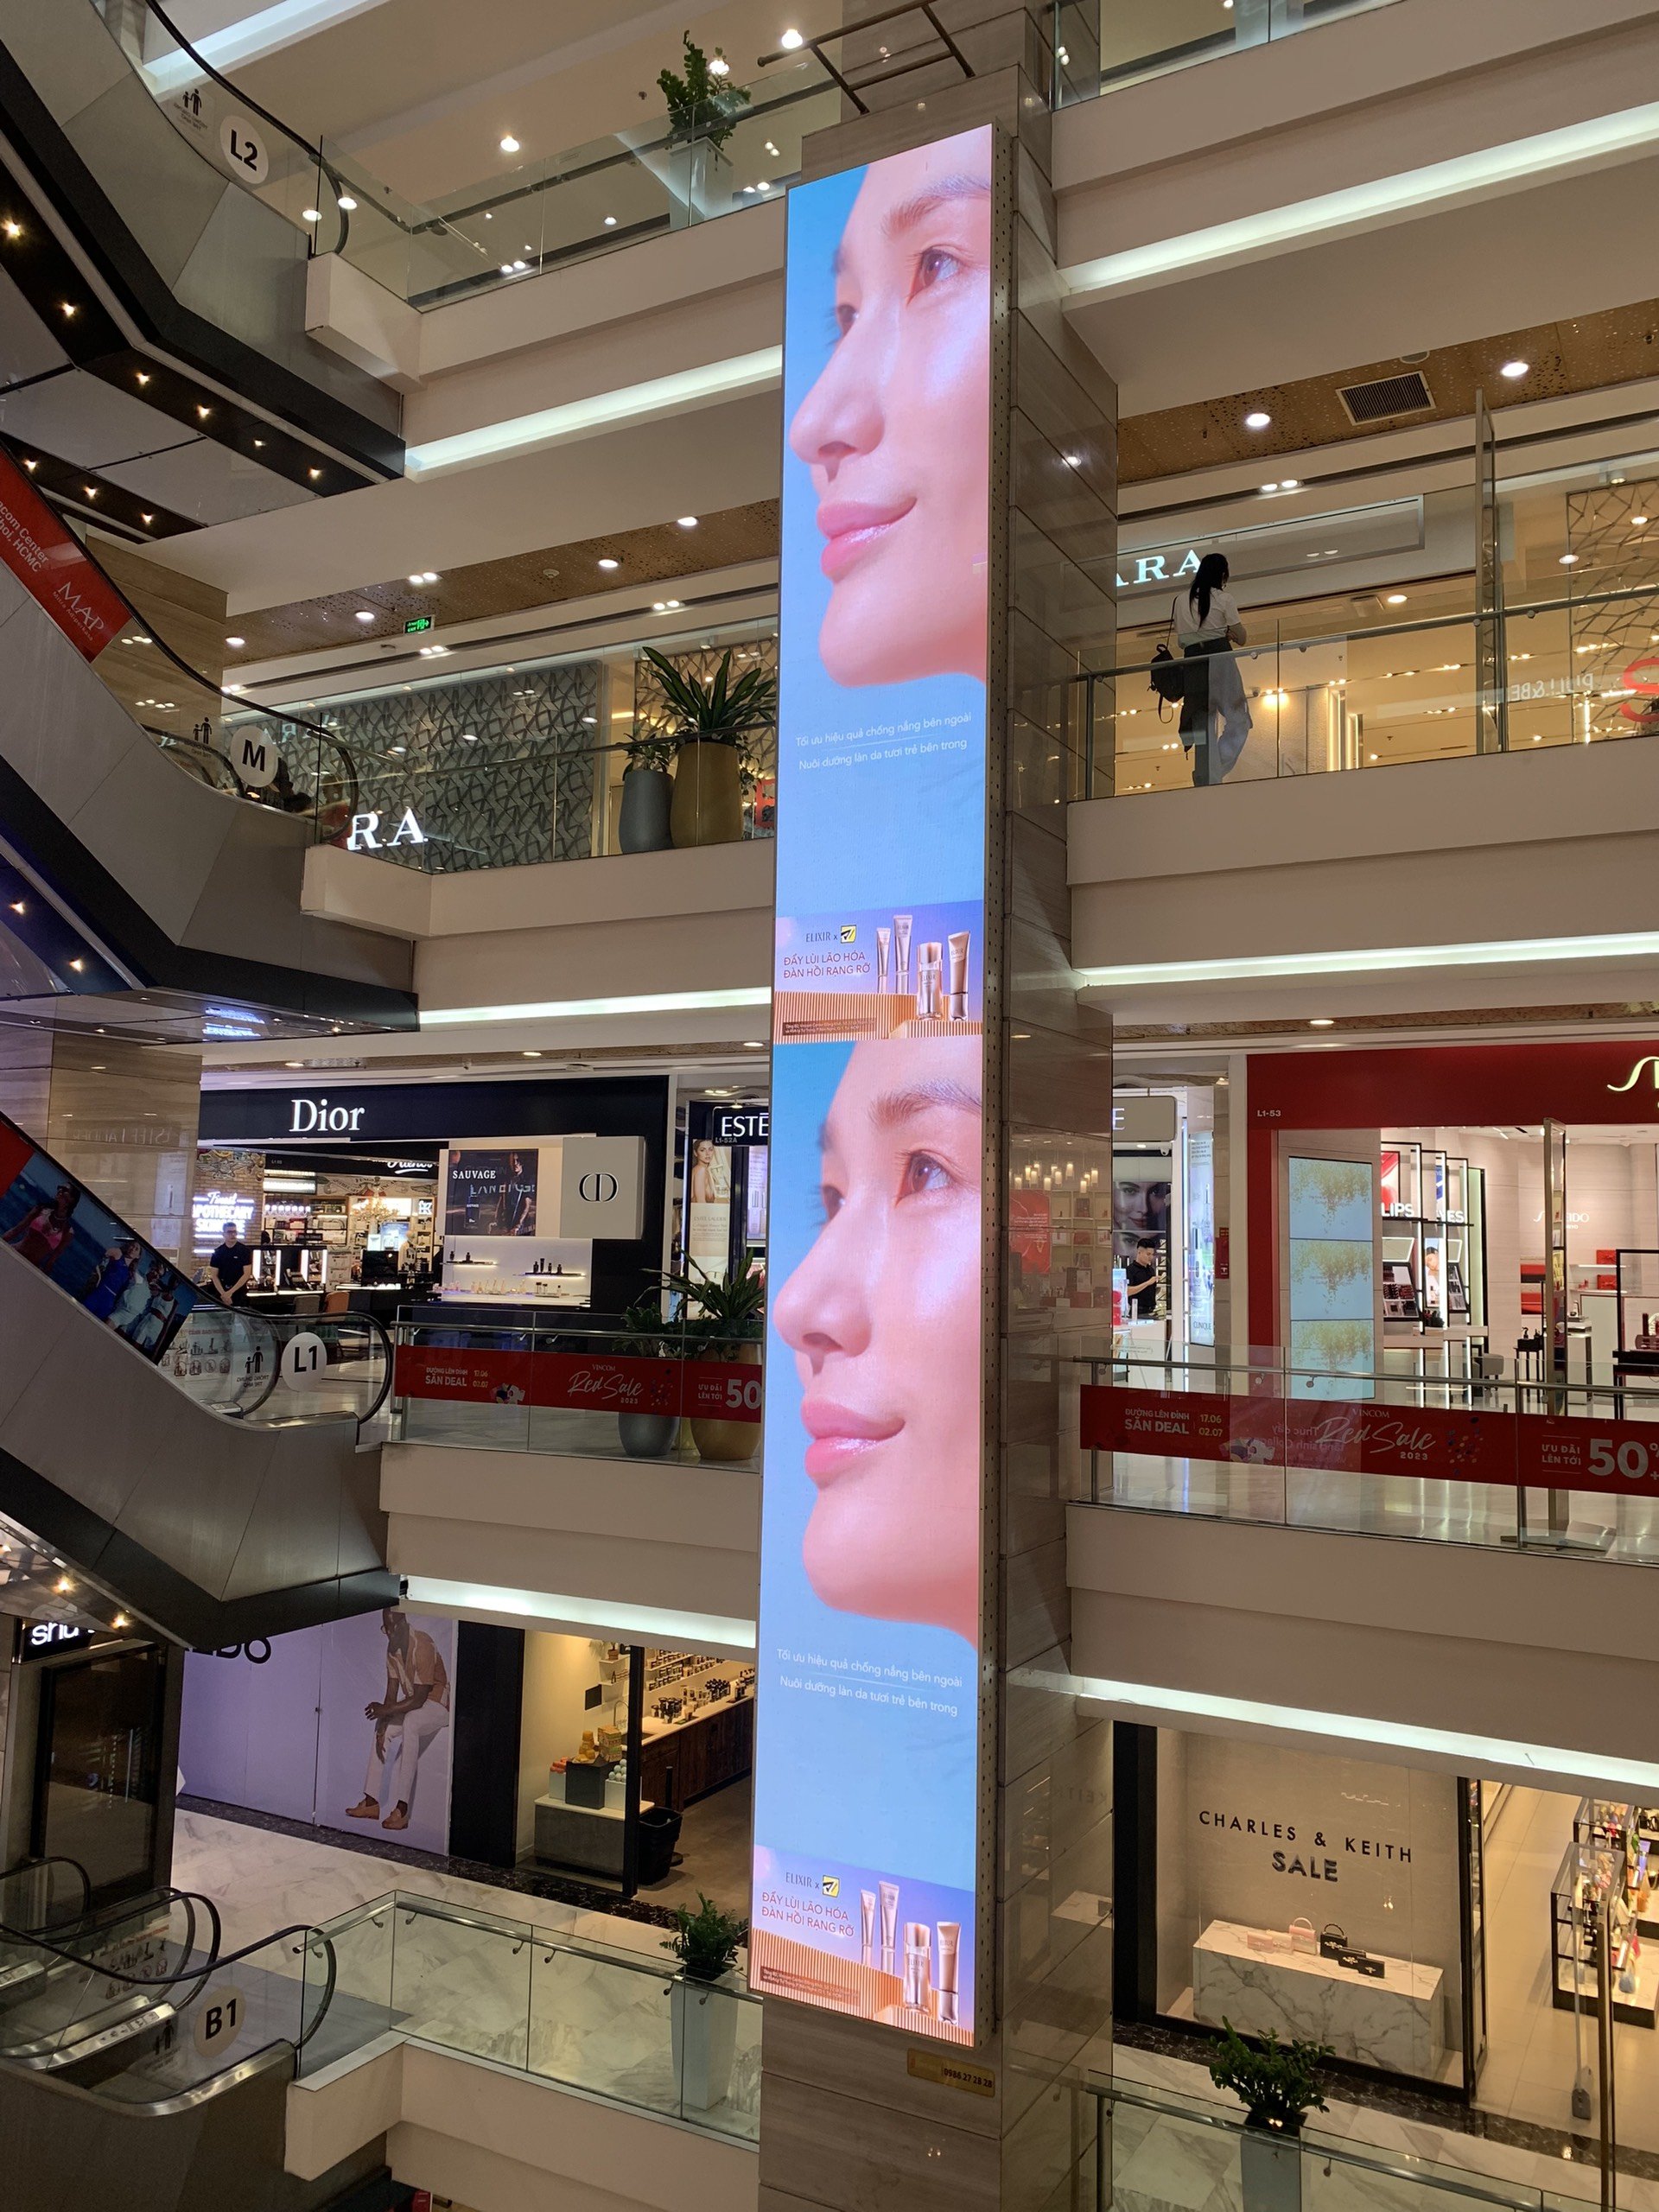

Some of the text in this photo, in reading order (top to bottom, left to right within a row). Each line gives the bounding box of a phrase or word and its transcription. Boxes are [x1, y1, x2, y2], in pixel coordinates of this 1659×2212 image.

[231, 129, 258, 172] L2
[19, 528, 49, 563] Center
[13, 538, 41, 572] HCMC
[57, 581, 105, 632] MAP
[923, 717, 942, 728] bên
[944, 711, 972, 727] ngoài
[242, 739, 266, 772] M
[798, 759, 820, 771] Nuôi
[870, 749, 882, 760] da
[920, 741, 938, 753] bên
[941, 739, 968, 752] trong
[805, 931, 831, 943] ELIXIR
[805, 951, 819, 964] LÙI
[822, 951, 842, 963] LÃO
[843, 949, 866, 962] HÓA
[783, 966, 804, 979] ĐÀN
[806, 964, 824, 977] HỒI
[826, 965, 854, 979] RẠNG
[289, 1097, 365, 1133] Dior
[452, 1169, 497, 1179] SAUVAGE
[1381, 1202, 1415, 1217] LIPS
[294, 1344, 318, 1373] L1
[592, 1363, 616, 1372] VINCOM
[425, 1373, 467, 1387] SĂN DEAL
[726, 1378, 761, 1410] 50
[1125, 1407, 1190, 1421] ĐƯỜNG LÊN ĐỈNH
[1200, 1414, 1222, 1424] 17.06
[1352, 1408, 1390, 1419] VINCOM
[1125, 1416, 1190, 1434] SĂN DEAL
[1198, 1427, 1223, 1437] 02.07
[1400, 1451, 1428, 1460] 2023
[1541, 1444, 1580, 1454] ƯU ĐÃI
[1541, 1453, 1581, 1465] LÊN TỚI
[777, 1648, 963, 1688] Tối ưu hiệu quả chống nắng bên ngoài
[779, 1675, 958, 1718] Nuôi dưỡng làn da tươi trẻ bên trong
[1198, 1810, 1412, 1863] CHARLES & KEITH
[1271, 1849, 1339, 1883] SALE
[785, 1872, 812, 1889] ELIXIR
[785, 1895, 800, 1910] LÙI
[803, 1900, 823, 1915] LÃO
[825, 1905, 849, 1921] HÓA
[761, 1905, 784, 1921] ĐÀN
[786, 1911, 804, 1926] HỒI
[807, 1917, 836, 1934] RẠNG
[206, 1998, 238, 2041] B1
[963, 2072, 972, 2082] 27
[983, 2078, 993, 2088] 28
